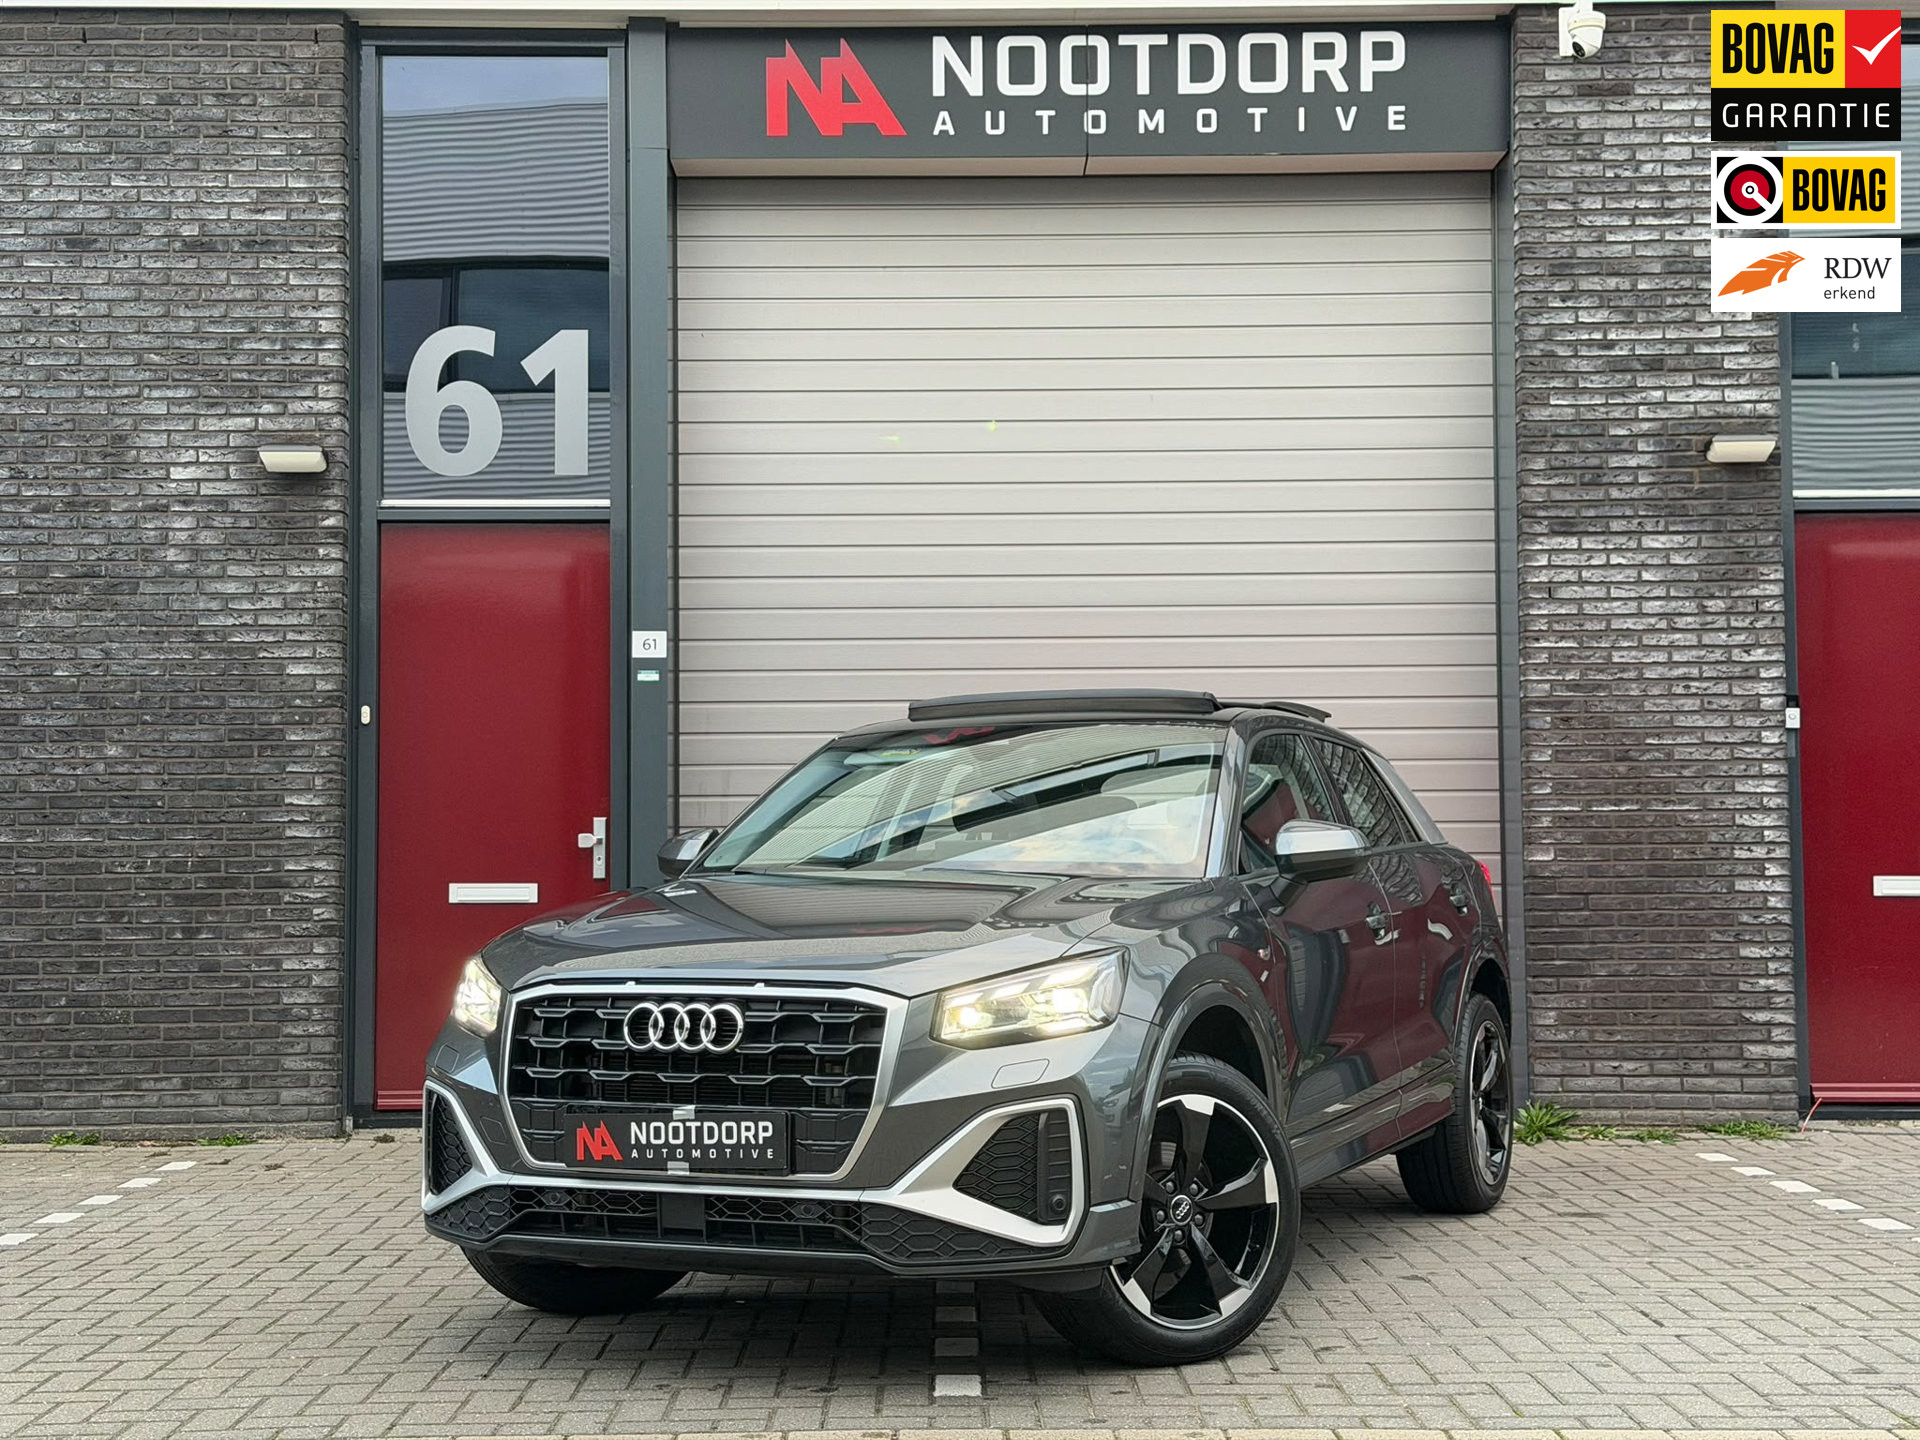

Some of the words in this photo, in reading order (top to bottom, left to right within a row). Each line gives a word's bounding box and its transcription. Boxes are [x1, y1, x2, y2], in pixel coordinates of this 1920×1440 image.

[931, 30, 1406, 97] NOOTDORP
[932, 105, 1407, 136] AUTOMOTIVE
[405, 324, 589, 477] 61
[642, 638, 657, 650] 61
[630, 1121, 774, 1145] NOOTDORP
[631, 1148, 774, 1159] AUTOMOTIVE
